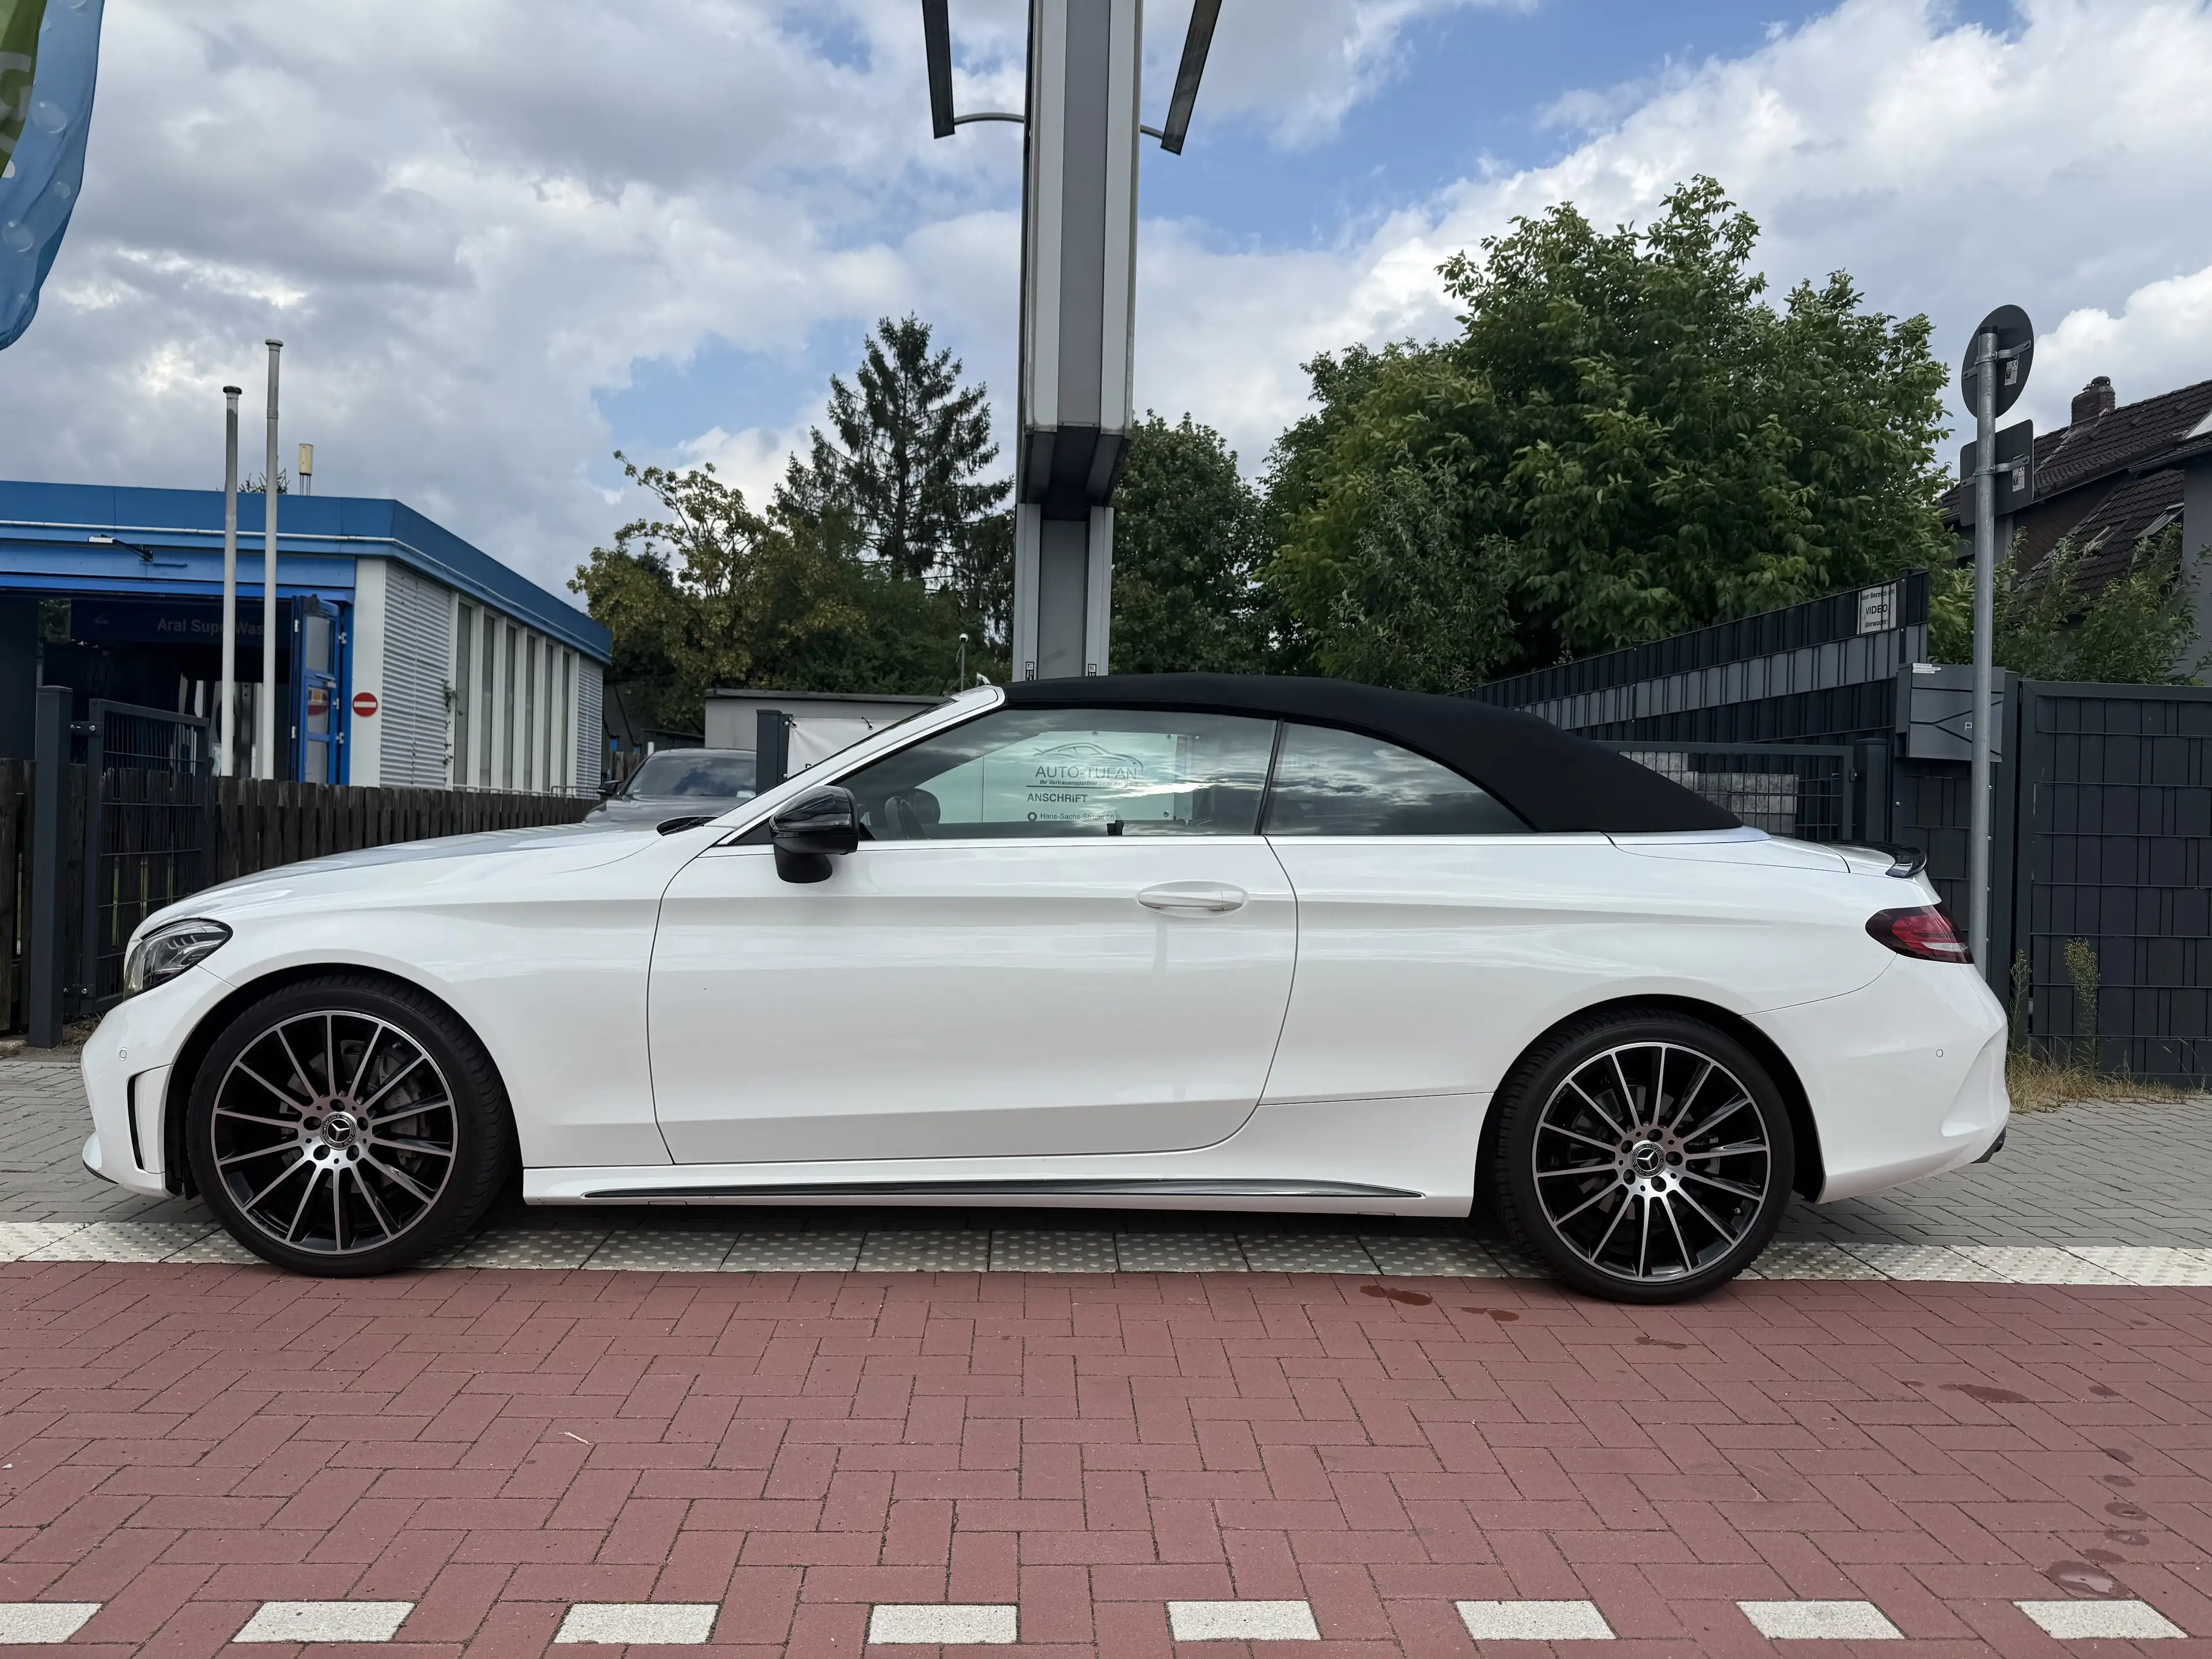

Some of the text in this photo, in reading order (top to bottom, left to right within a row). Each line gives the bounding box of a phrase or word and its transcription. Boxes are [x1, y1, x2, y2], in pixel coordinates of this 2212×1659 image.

[1866, 604, 1888, 615] VIDEO
[157, 618, 186, 632] Aral
[1035, 766, 1137, 779] AUTO-TUFAN
[1027, 793, 1088, 802] ANSCHRIFT
[1040, 813, 1104, 821] Hans-Sachs-Straße
